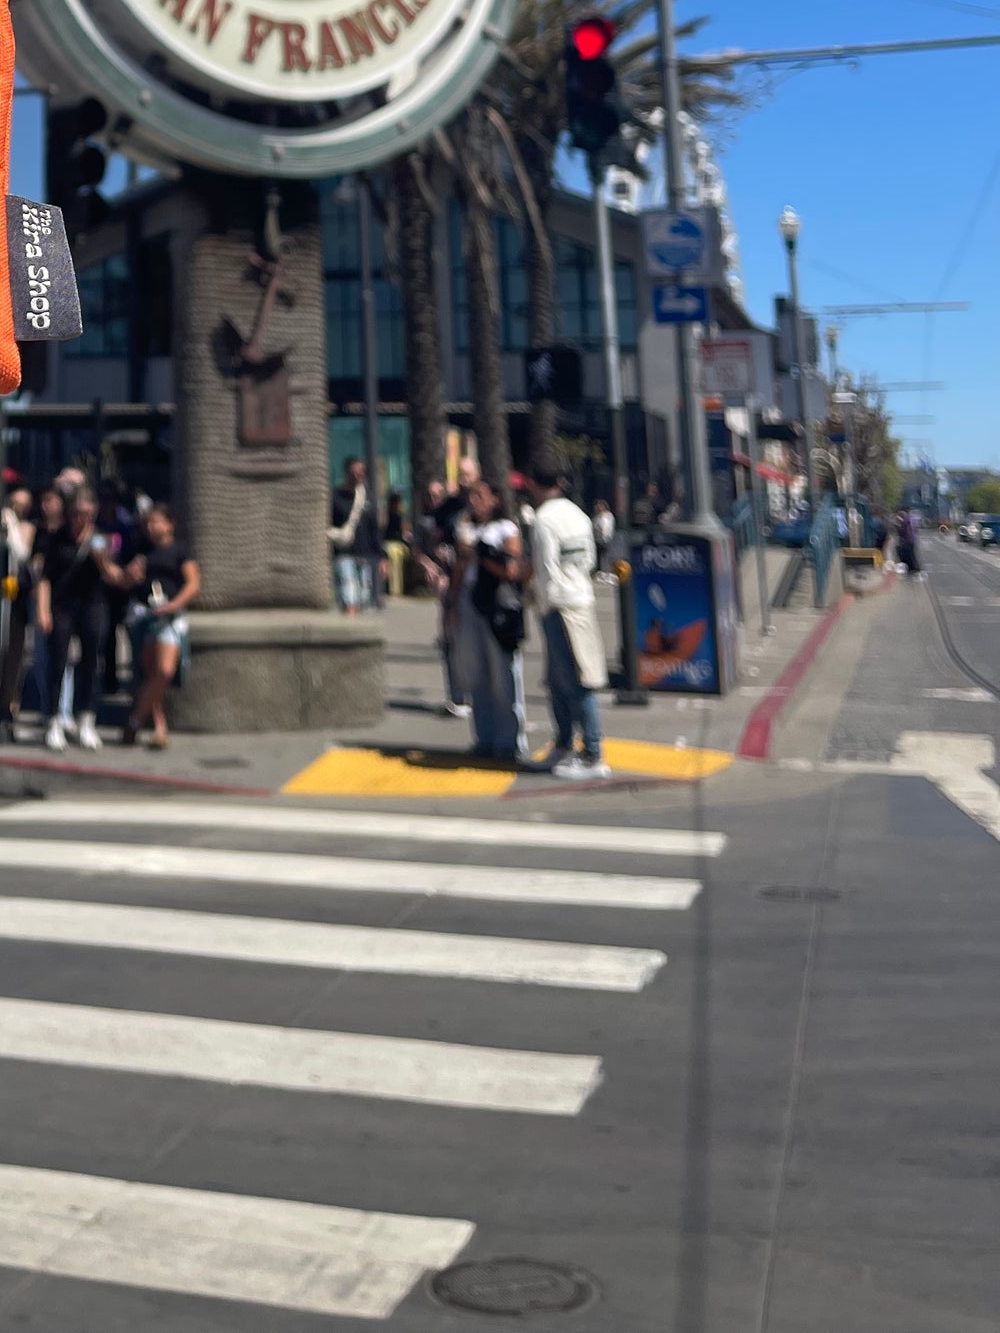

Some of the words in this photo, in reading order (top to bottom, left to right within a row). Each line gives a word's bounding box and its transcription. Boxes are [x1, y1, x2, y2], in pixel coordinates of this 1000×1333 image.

[21, 204, 43, 258] Kira
[39, 209, 52, 235] The
[26, 265, 51, 330] Shop
